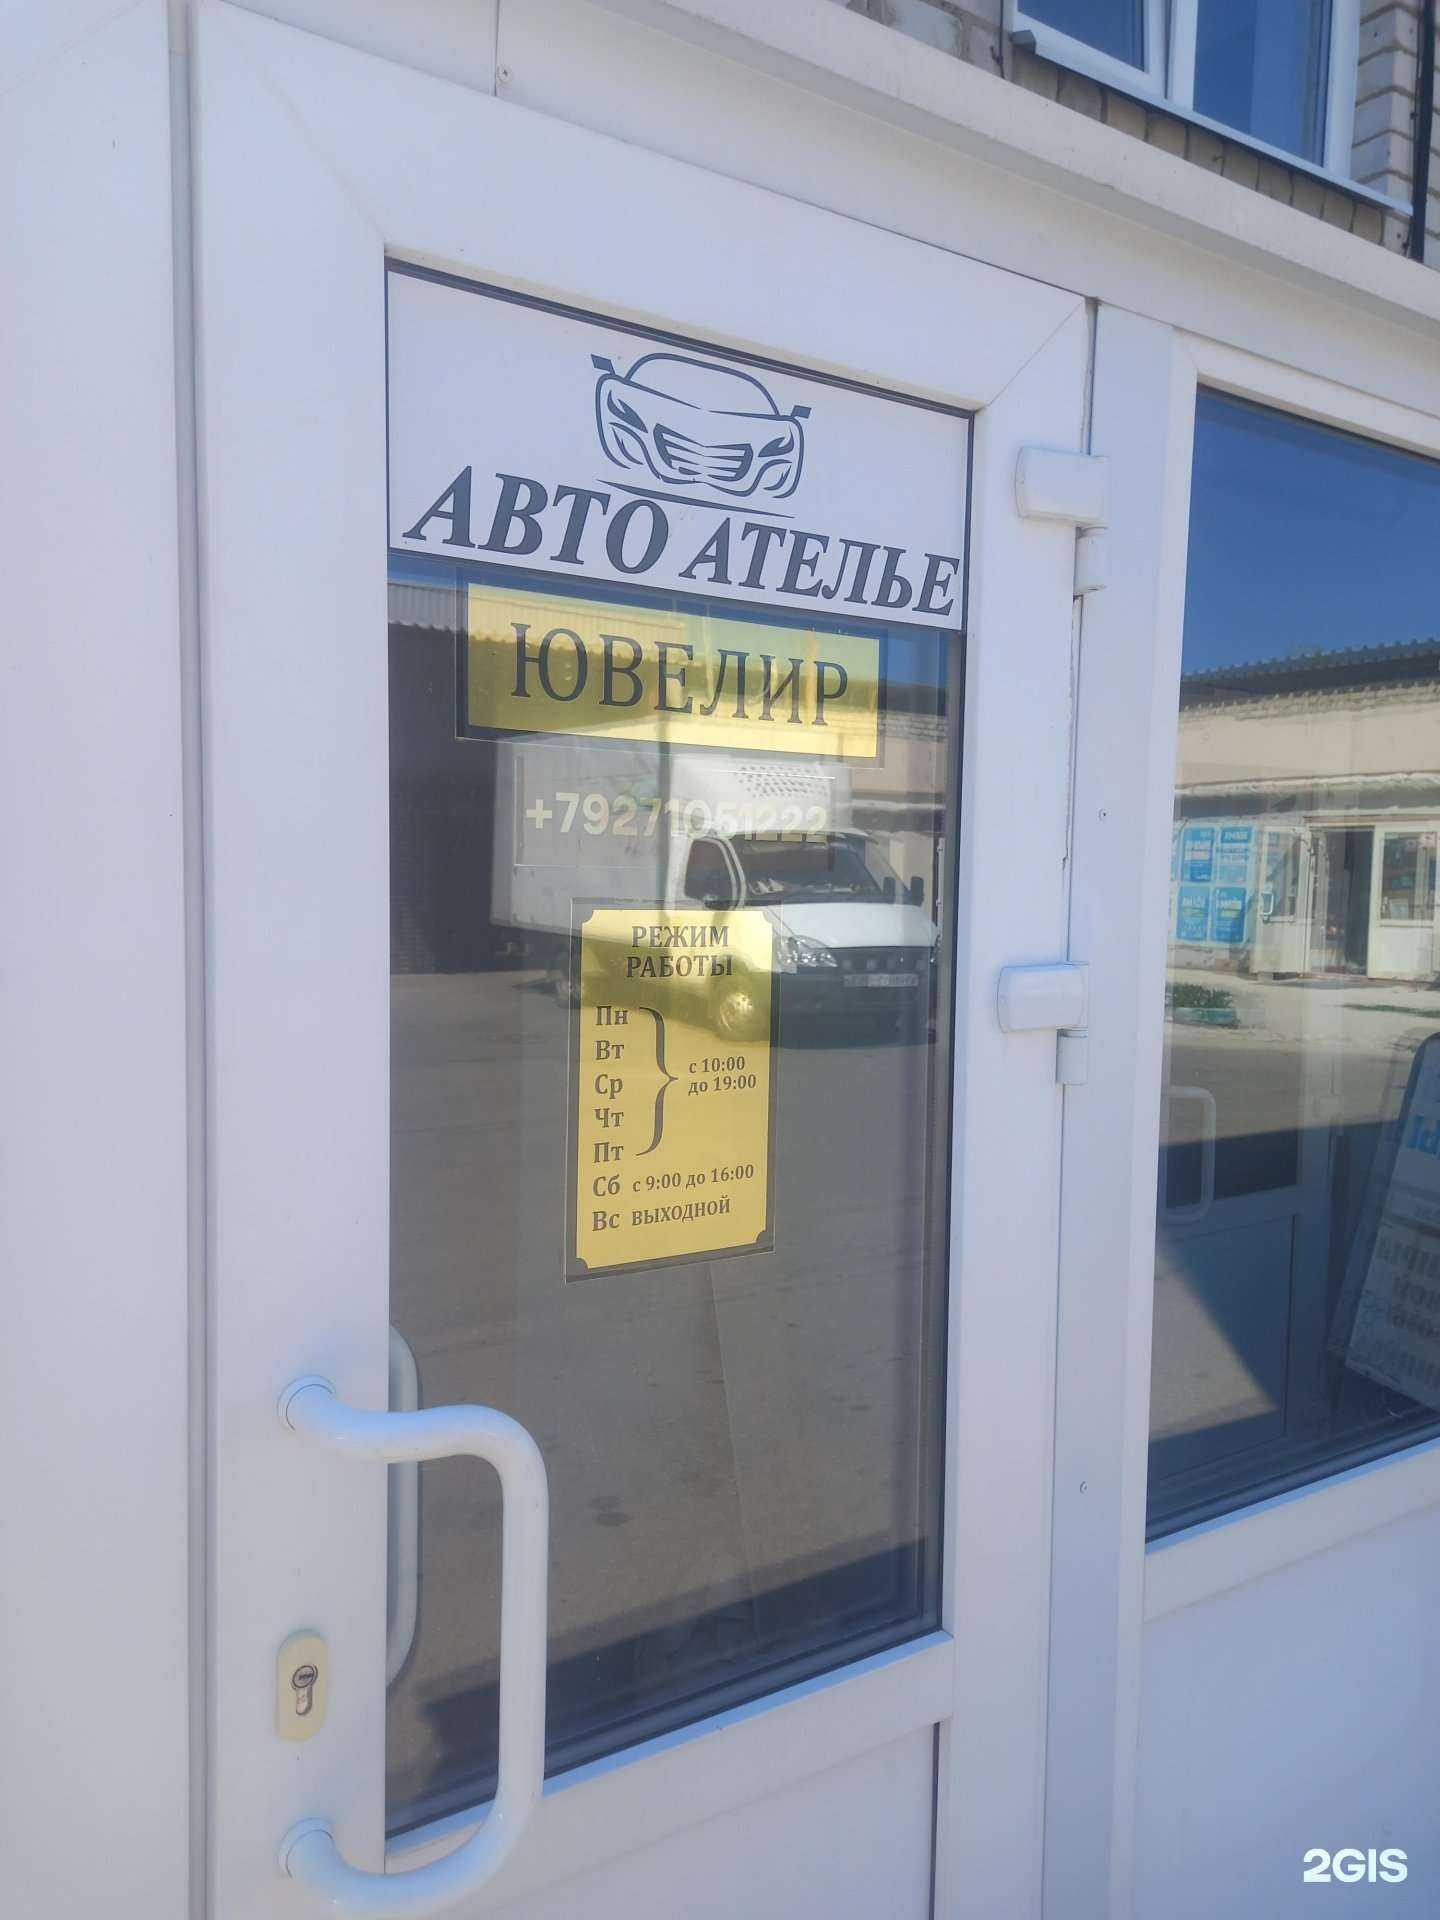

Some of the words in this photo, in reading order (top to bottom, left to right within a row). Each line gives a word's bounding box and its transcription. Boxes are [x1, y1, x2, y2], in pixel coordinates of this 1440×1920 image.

[402, 465, 669, 575] АВТО
[678, 516, 960, 617] АТЕЛЬЕ
[510, 622, 848, 726] ЮВЕЛИР
[525, 791, 828, 845] +79271051222
[631, 925, 730, 948] РЕЖИМ
[626, 955, 733, 978] РАБОТЫ
[596, 1005, 628, 1026] Пн
[595, 1040, 624, 1060] Вт
[688, 1062, 697, 1074] с
[702, 1056, 746, 1073] 10:00
[594, 1073, 623, 1100] Ср
[688, 1081, 708, 1096] до
[713, 1074, 757, 1092] 19:00
[594, 1107, 624, 1128] Чт
[593, 1141, 624, 1163] Пт
[592, 1174, 620, 1197] Сб
[632, 1180, 641, 1193] с
[646, 1172, 681, 1191] 9:00
[686, 1173, 706, 1190] до
[711, 1164, 754, 1183] 16:00
[592, 1210, 620, 1232] Вс
[631, 1194, 730, 1226] ВЫХОДНОЙ
